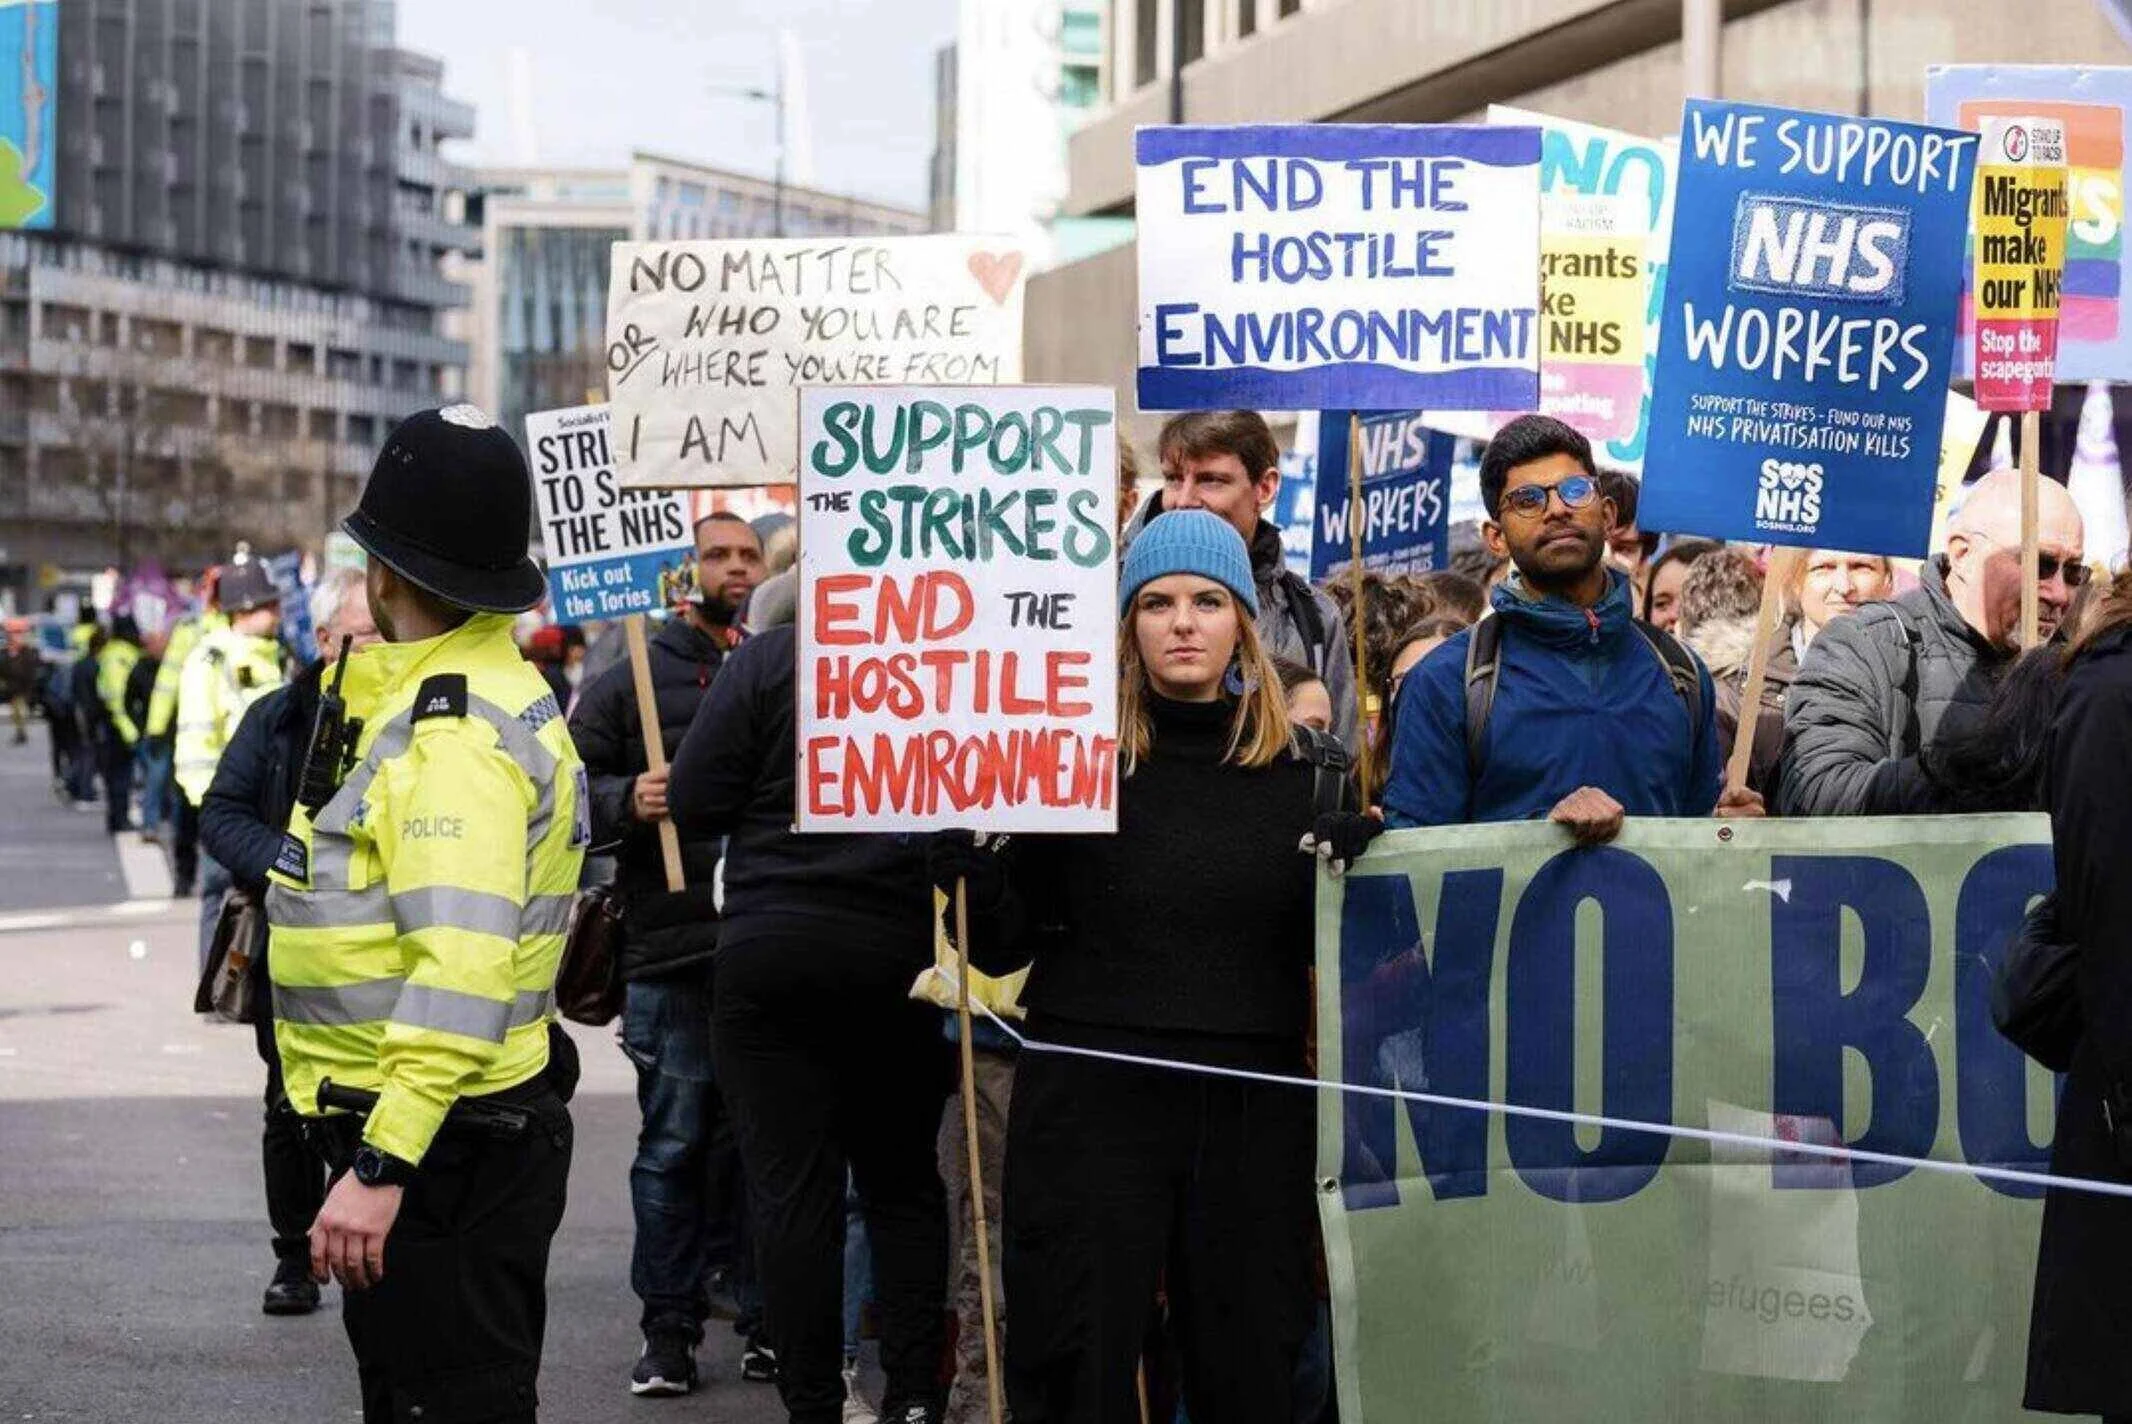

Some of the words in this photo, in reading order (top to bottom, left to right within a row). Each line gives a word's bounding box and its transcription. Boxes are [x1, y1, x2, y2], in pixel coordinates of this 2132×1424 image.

[1693, 110, 1764, 167] WE
[1776, 118, 1977, 193] SUPPORT
[1182, 159, 1323, 214] END
[1345, 160, 1469, 212] THE
[631, 251, 706, 292] NO
[720, 247, 902, 295] MATTER
[1232, 231, 1455, 284] HOSTILE
[1740, 206, 1902, 292] NHS
[1983, 227, 2046, 265] make
[1983, 279, 2026, 309] our
[684, 305, 780, 338] WHO
[801, 306, 881, 341] YOU
[893, 305, 977, 339] ARE
[1156, 303, 1536, 366] ENVIRONMENT
[1551, 320, 1622, 356] NHS
[1683, 302, 1930, 391] WORKERS
[1981, 328, 2015, 358] Stop
[608, 323, 657, 372] OR
[662, 350, 768, 387] WHERE
[903, 351, 999, 384] FROM
[629, 414, 641, 462] I
[680, 412, 768, 463] AM
[811, 401, 1113, 478] SUPPORT
[1687, 415, 1727, 438] NHS
[1730, 417, 1860, 454] PRIVATISATION
[1864, 434, 1912, 459] KILLS
[1690, 395, 1744, 415] SUPPORT
[1746, 399, 1768, 416] THE
[1771, 402, 1816, 422] STRIKES
[1828, 408, 1860, 427] FUND
[1862, 412, 1886, 431] OUR
[1888, 416, 1912, 433] NHS
[537, 428, 616, 475] STRI
[542, 474, 584, 516] TO
[1755, 487, 1822, 524] NHS
[549, 513, 611, 557] THE
[620, 502, 684, 547] NHS
[807, 490, 853, 511] THE
[847, 485, 1112, 568] STRIKES
[561, 565, 599, 593] Kick
[604, 560, 633, 584] out
[566, 596, 595, 618] the
[597, 588, 652, 613] Tories
[814, 570, 975, 645] END
[1003, 591, 1077, 630] THE
[816, 649, 1093, 720] HOSTILE
[808, 727, 1118, 818] ENVIRONMENT
[402, 817, 466, 840] POLICE
[1341, 845, 1675, 1211] NO
